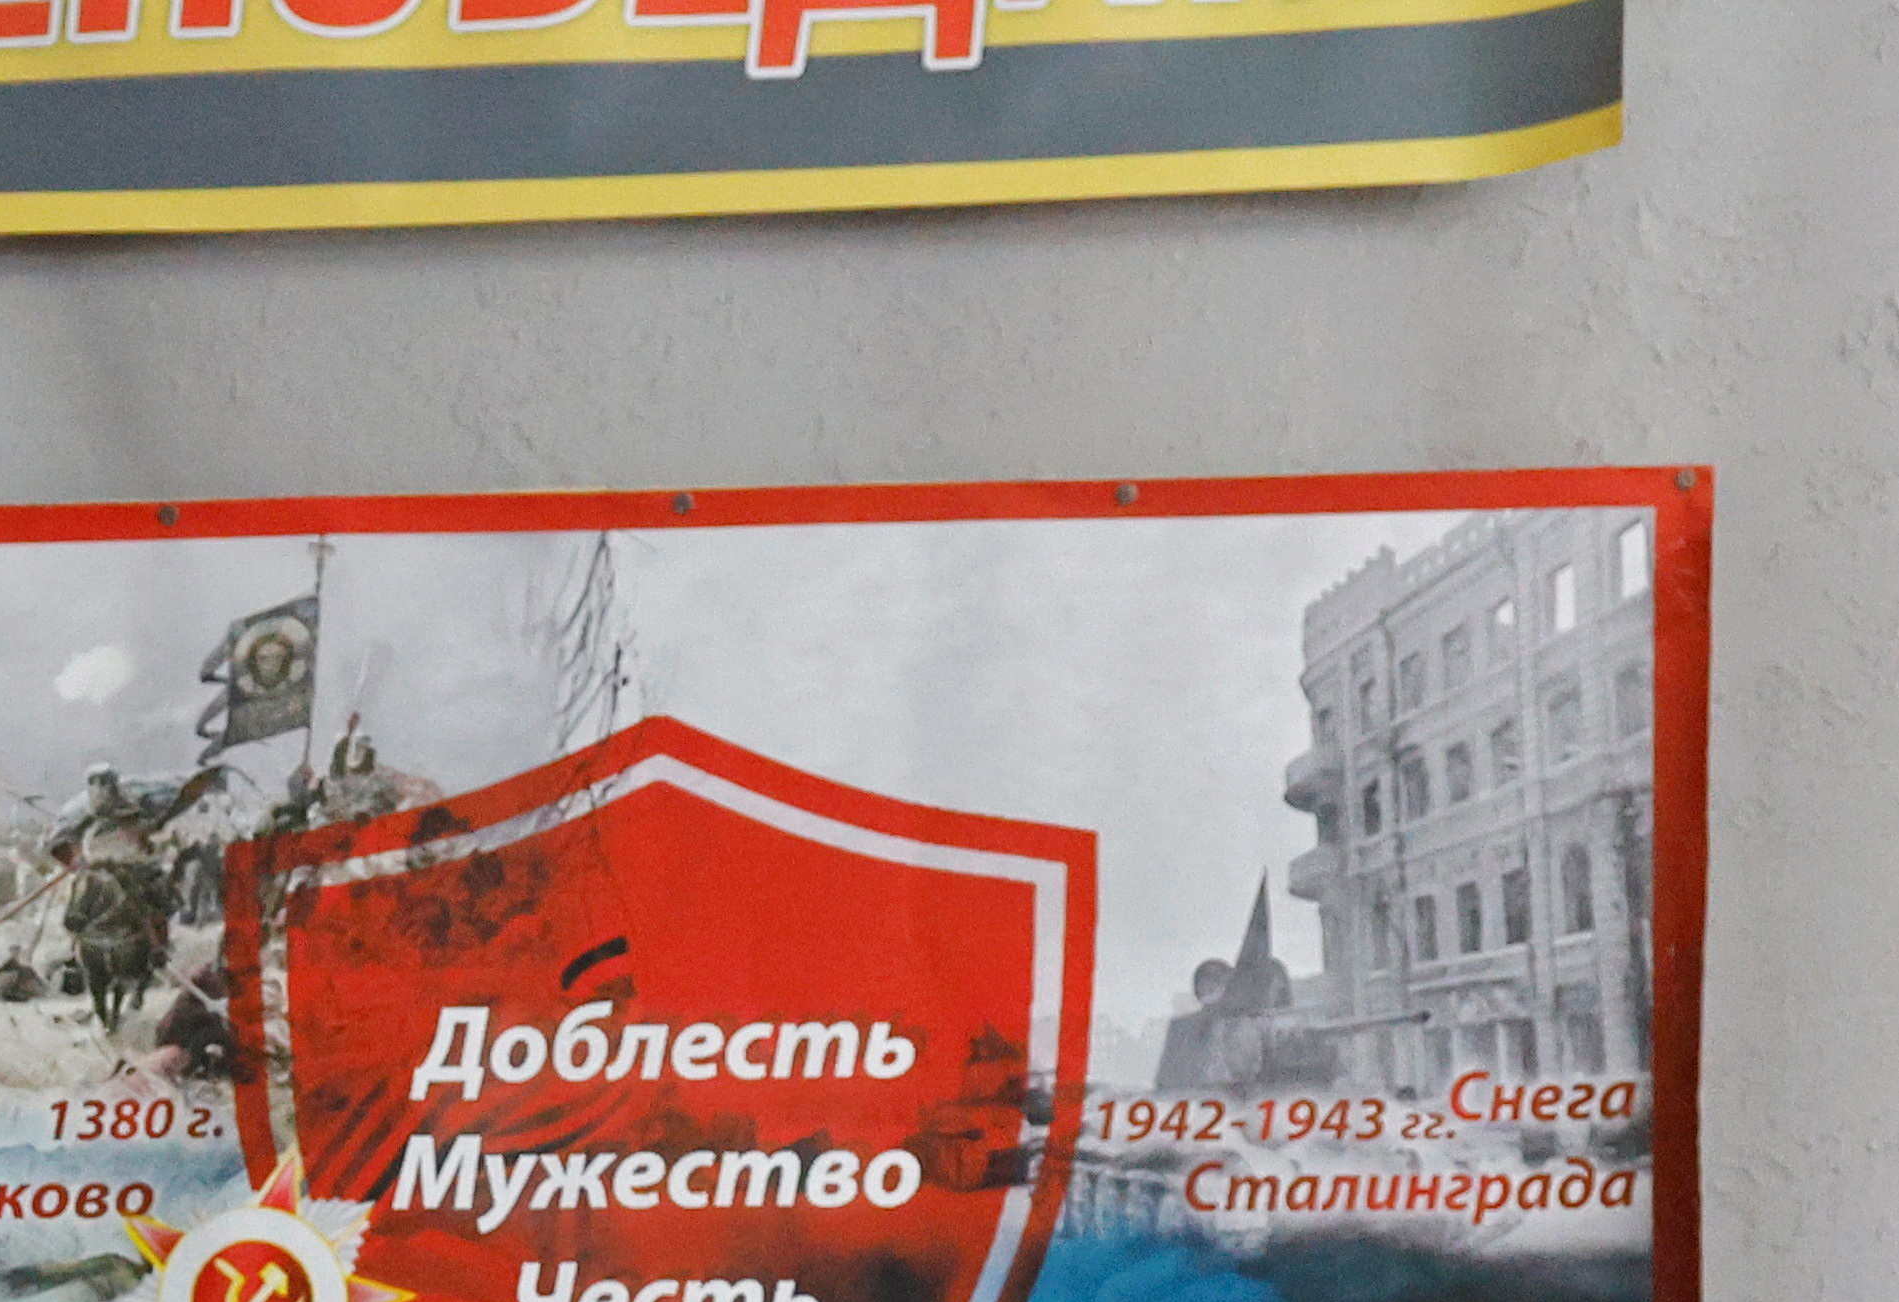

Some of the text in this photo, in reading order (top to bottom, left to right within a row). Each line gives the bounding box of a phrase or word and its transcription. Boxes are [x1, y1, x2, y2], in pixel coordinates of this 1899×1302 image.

[409, 1000, 917, 1101] Доблесть
[1449, 1070, 1637, 1122] Снега
[391, 1133, 923, 1235] Мужество
[1184, 1156, 1636, 1226] Сталинграда
